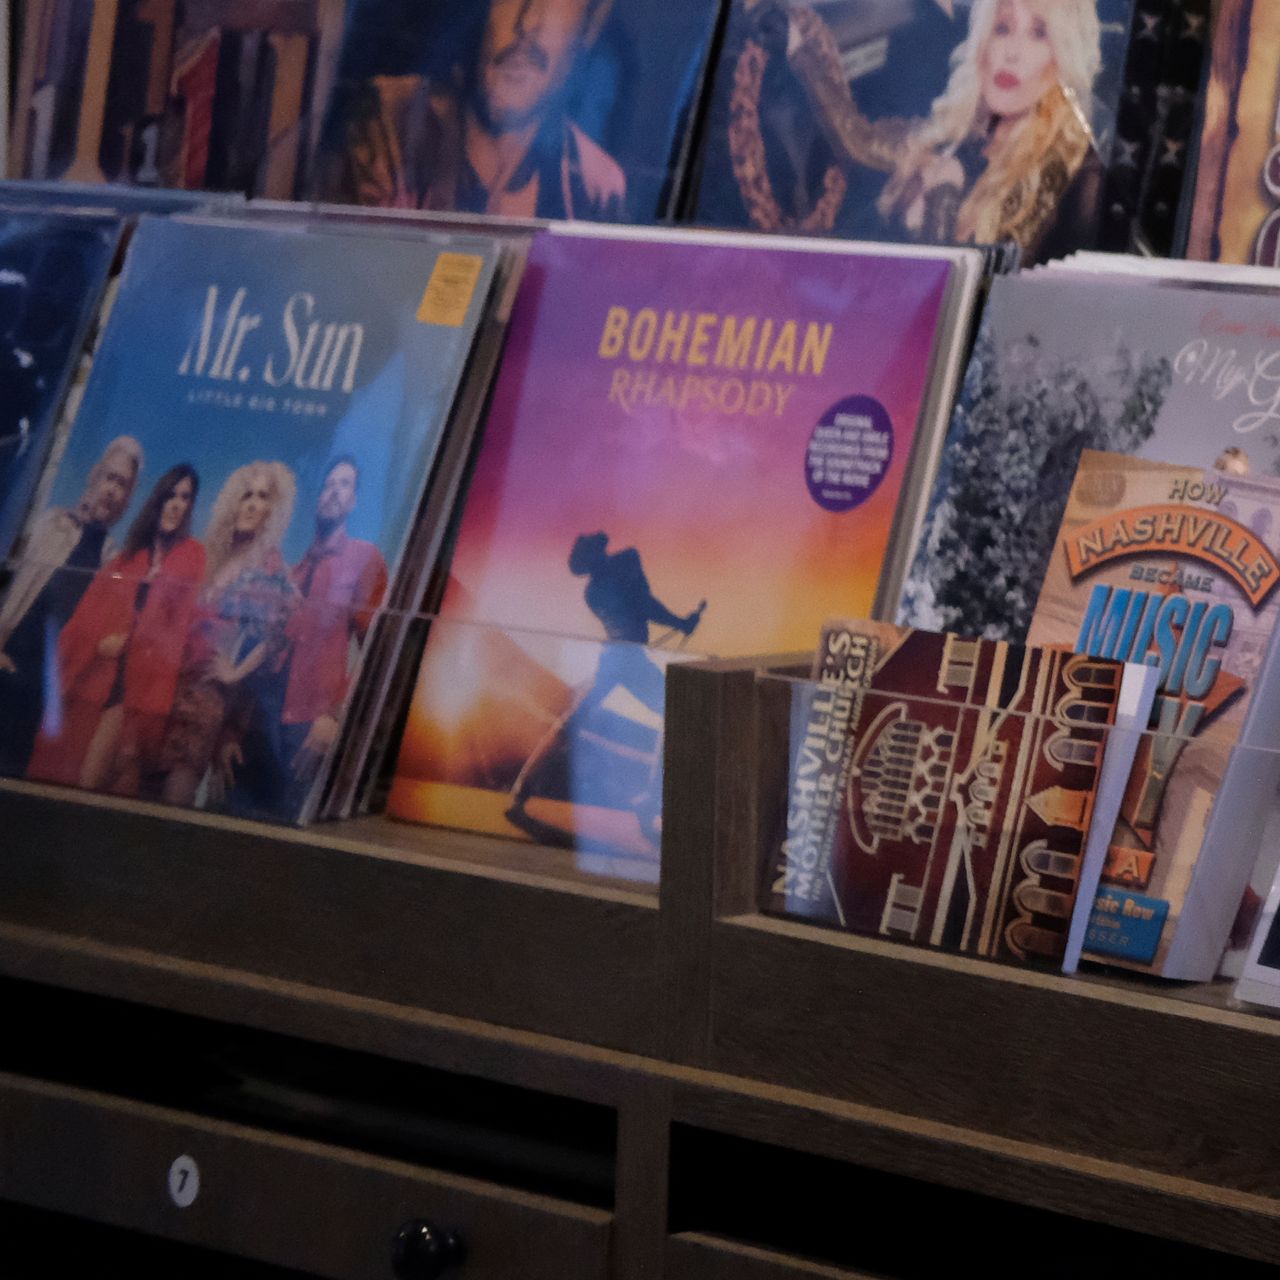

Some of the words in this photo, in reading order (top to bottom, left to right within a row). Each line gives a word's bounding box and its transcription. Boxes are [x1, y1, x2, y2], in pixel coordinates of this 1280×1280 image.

[177, 283, 262, 383] Mr.
[262, 291, 365, 394] Sun
[598, 306, 834, 376] BOHEMIAN
[607, 368, 797, 417] RHAPSODY
[1169, 478, 1227, 504] HOW
[1080, 512, 1273, 593] NASHVILLE
[1129, 563, 1215, 592] BECAME
[1073, 583, 1234, 699] MUSIC
[771, 630, 851, 897] NASHVILLE'S
[795, 771, 838, 901] MOTHER
[824, 634, 870, 764] CHURCH
[1123, 854, 1140, 881] A
[1122, 898, 1155, 920] Row
[176, 1168, 191, 1194] 7
